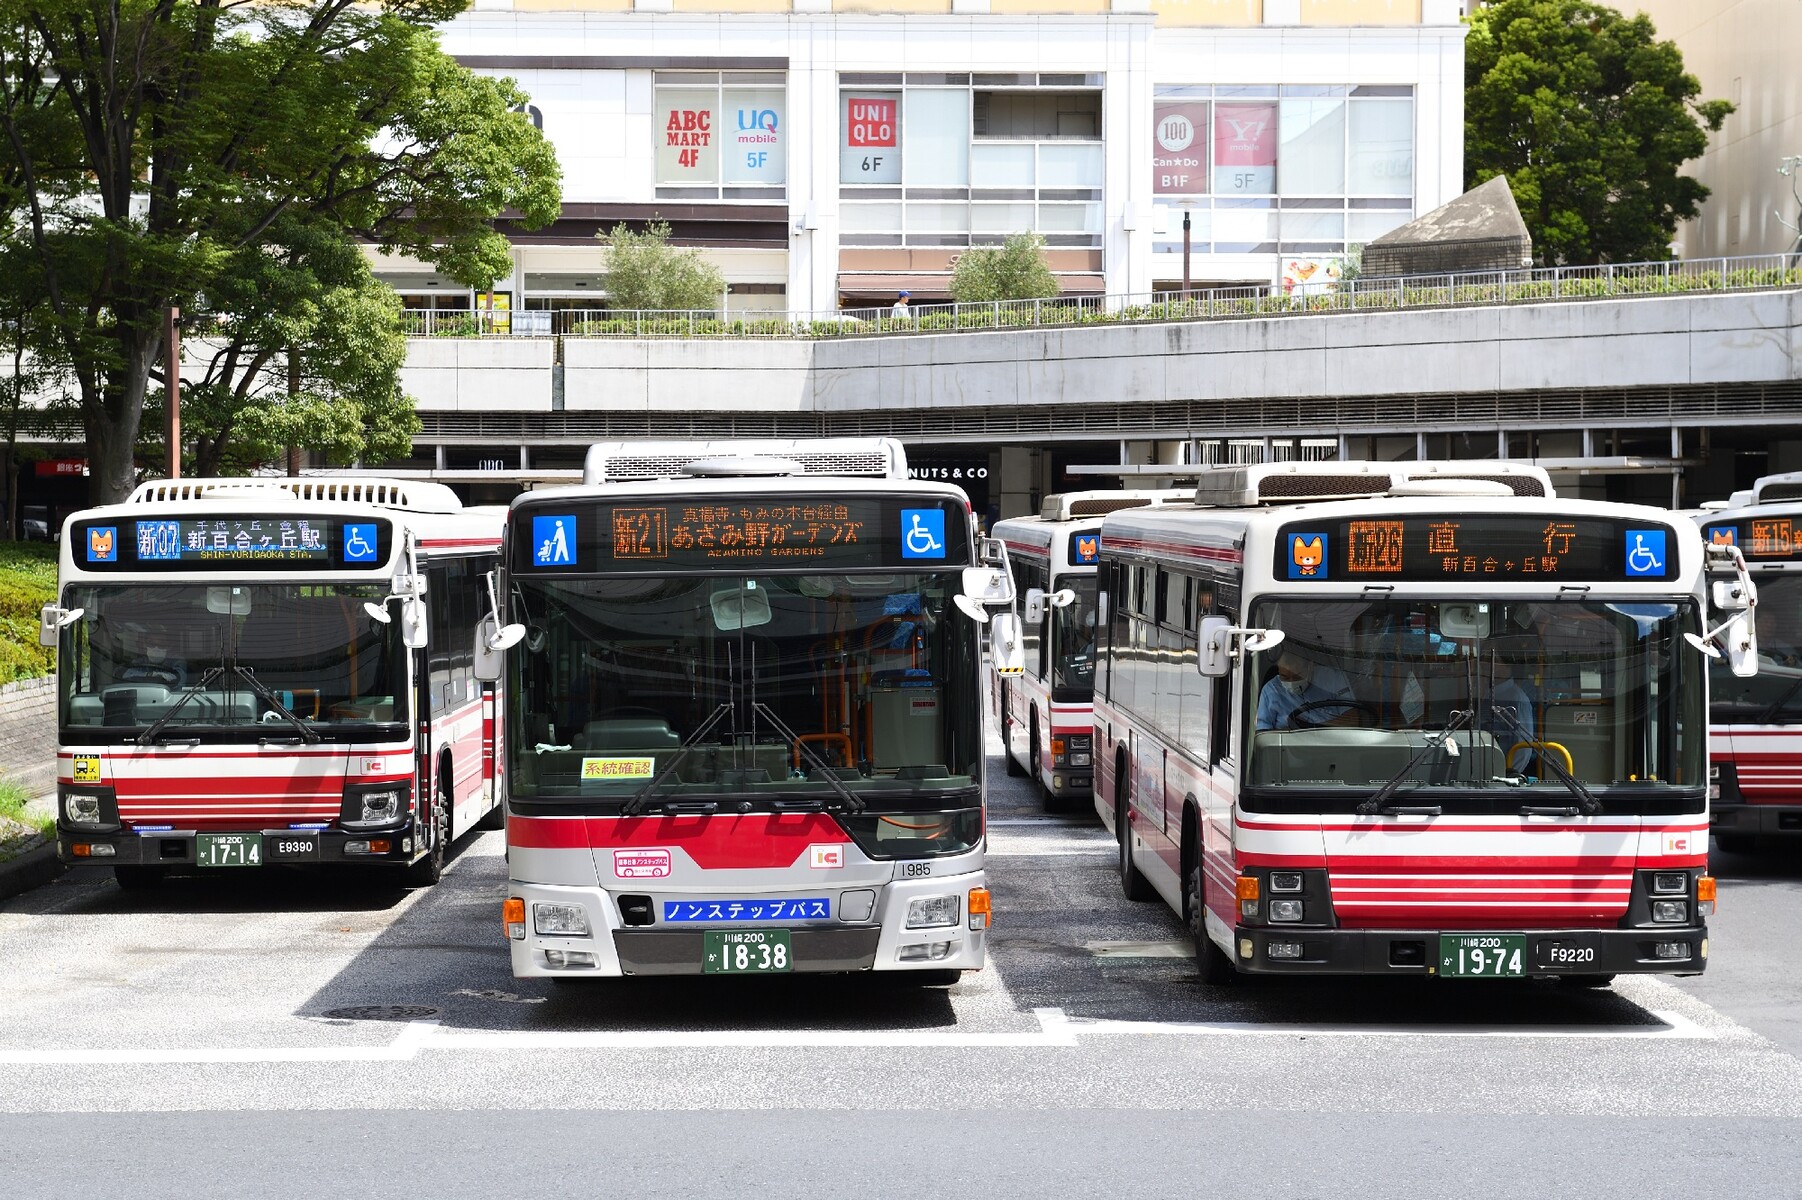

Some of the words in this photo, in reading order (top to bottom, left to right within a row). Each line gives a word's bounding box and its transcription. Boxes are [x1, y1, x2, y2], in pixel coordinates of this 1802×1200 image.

[667, 110, 711, 131] ABC
[738, 109, 778, 134] UQ
[853, 105, 888, 122] UNI
[667, 132, 711, 146] MART
[738, 134, 777, 144] mobile
[853, 124, 891, 144] QLO
[1163, 121, 1187, 141] 100
[1229, 143, 1260, 152] mobile
[678, 149, 699, 168] 4F
[747, 151, 768, 168] 5F
[861, 156, 884, 172] 6F
[1161, 175, 1189, 187] B1F
[1234, 173, 1256, 189] 5F
[908, 467, 949, 479] NUTS
[952, 467, 963, 479] &
[966, 467, 988, 479] CO
[137, 521, 180, 557] 新07
[615, 511, 663, 555] 新21
[671, 521, 864, 549] あざみ野ガーデンズ
[1753, 522, 1790, 554] 新15
[200, 551, 284, 560] SHIN-YURIGAOKA
[289, 551, 313, 560] STA.
[707, 548, 763, 558] AZAMINO
[770, 547, 826, 557] GARDENS
[585, 761, 652, 776] 系統確認
[211, 843, 260, 864] 17-14
[279, 841, 313, 853] E9390
[902, 862, 931, 877] 1985
[667, 901, 826, 919] ノンステップバス
[708, 953, 718, 962] か
[723, 943, 787, 970] 18-38
[1458, 948, 1522, 975] 19-74
[1551, 947, 1594, 962] F9220
